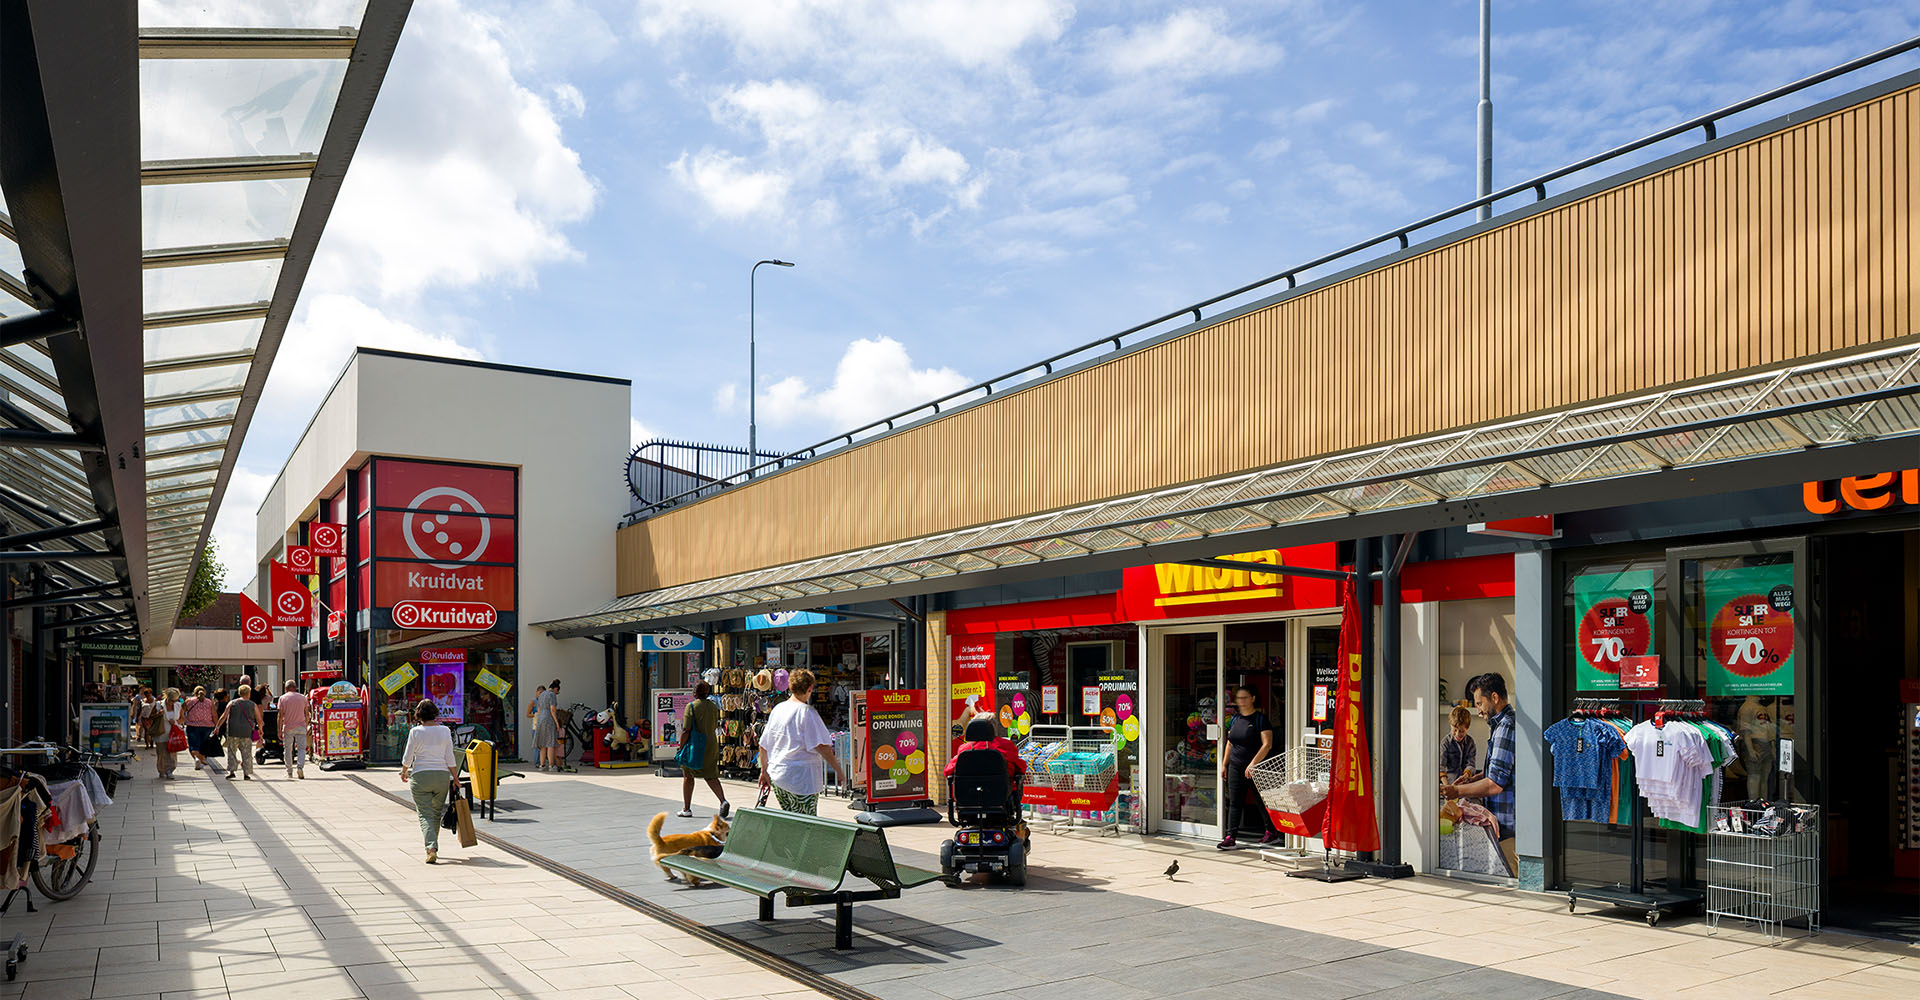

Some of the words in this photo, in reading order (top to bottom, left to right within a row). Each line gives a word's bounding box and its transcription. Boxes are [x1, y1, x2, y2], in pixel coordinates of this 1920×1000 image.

[408, 571, 484, 590] Kruidvat
[1600, 607, 1628, 618] SUPER
[1734, 604, 1768, 617] SUPER
[421, 607, 493, 625] Kruidvat
[1739, 615, 1764, 627] SALE
[1603, 617, 1625, 628] SALE
[1593, 628, 1624, 636] KORTINGEN
[1727, 628, 1764, 636] KORTINGEN
[659, 637, 685, 647] etos
[431, 651, 464, 660] Kruidvat
[1725, 636, 1780, 665] 70%
[1099, 682, 1137, 691] OPRUIMING
[883, 692, 911, 702] wibra
[1013, 700, 1025, 709] 70%
[1118, 702, 1131, 711] 70%
[1001, 711, 1012, 720] 50%
[1101, 715, 1115, 725] 50%
[872, 719, 923, 730] OPRUIMING
[1125, 723, 1138, 732] 70%
[899, 738, 915, 748] 70%
[1320, 738, 1333, 748] 50
[878, 752, 895, 761] 50%
[908, 757, 925, 766] 70%
[892, 768, 909, 776] 70%
